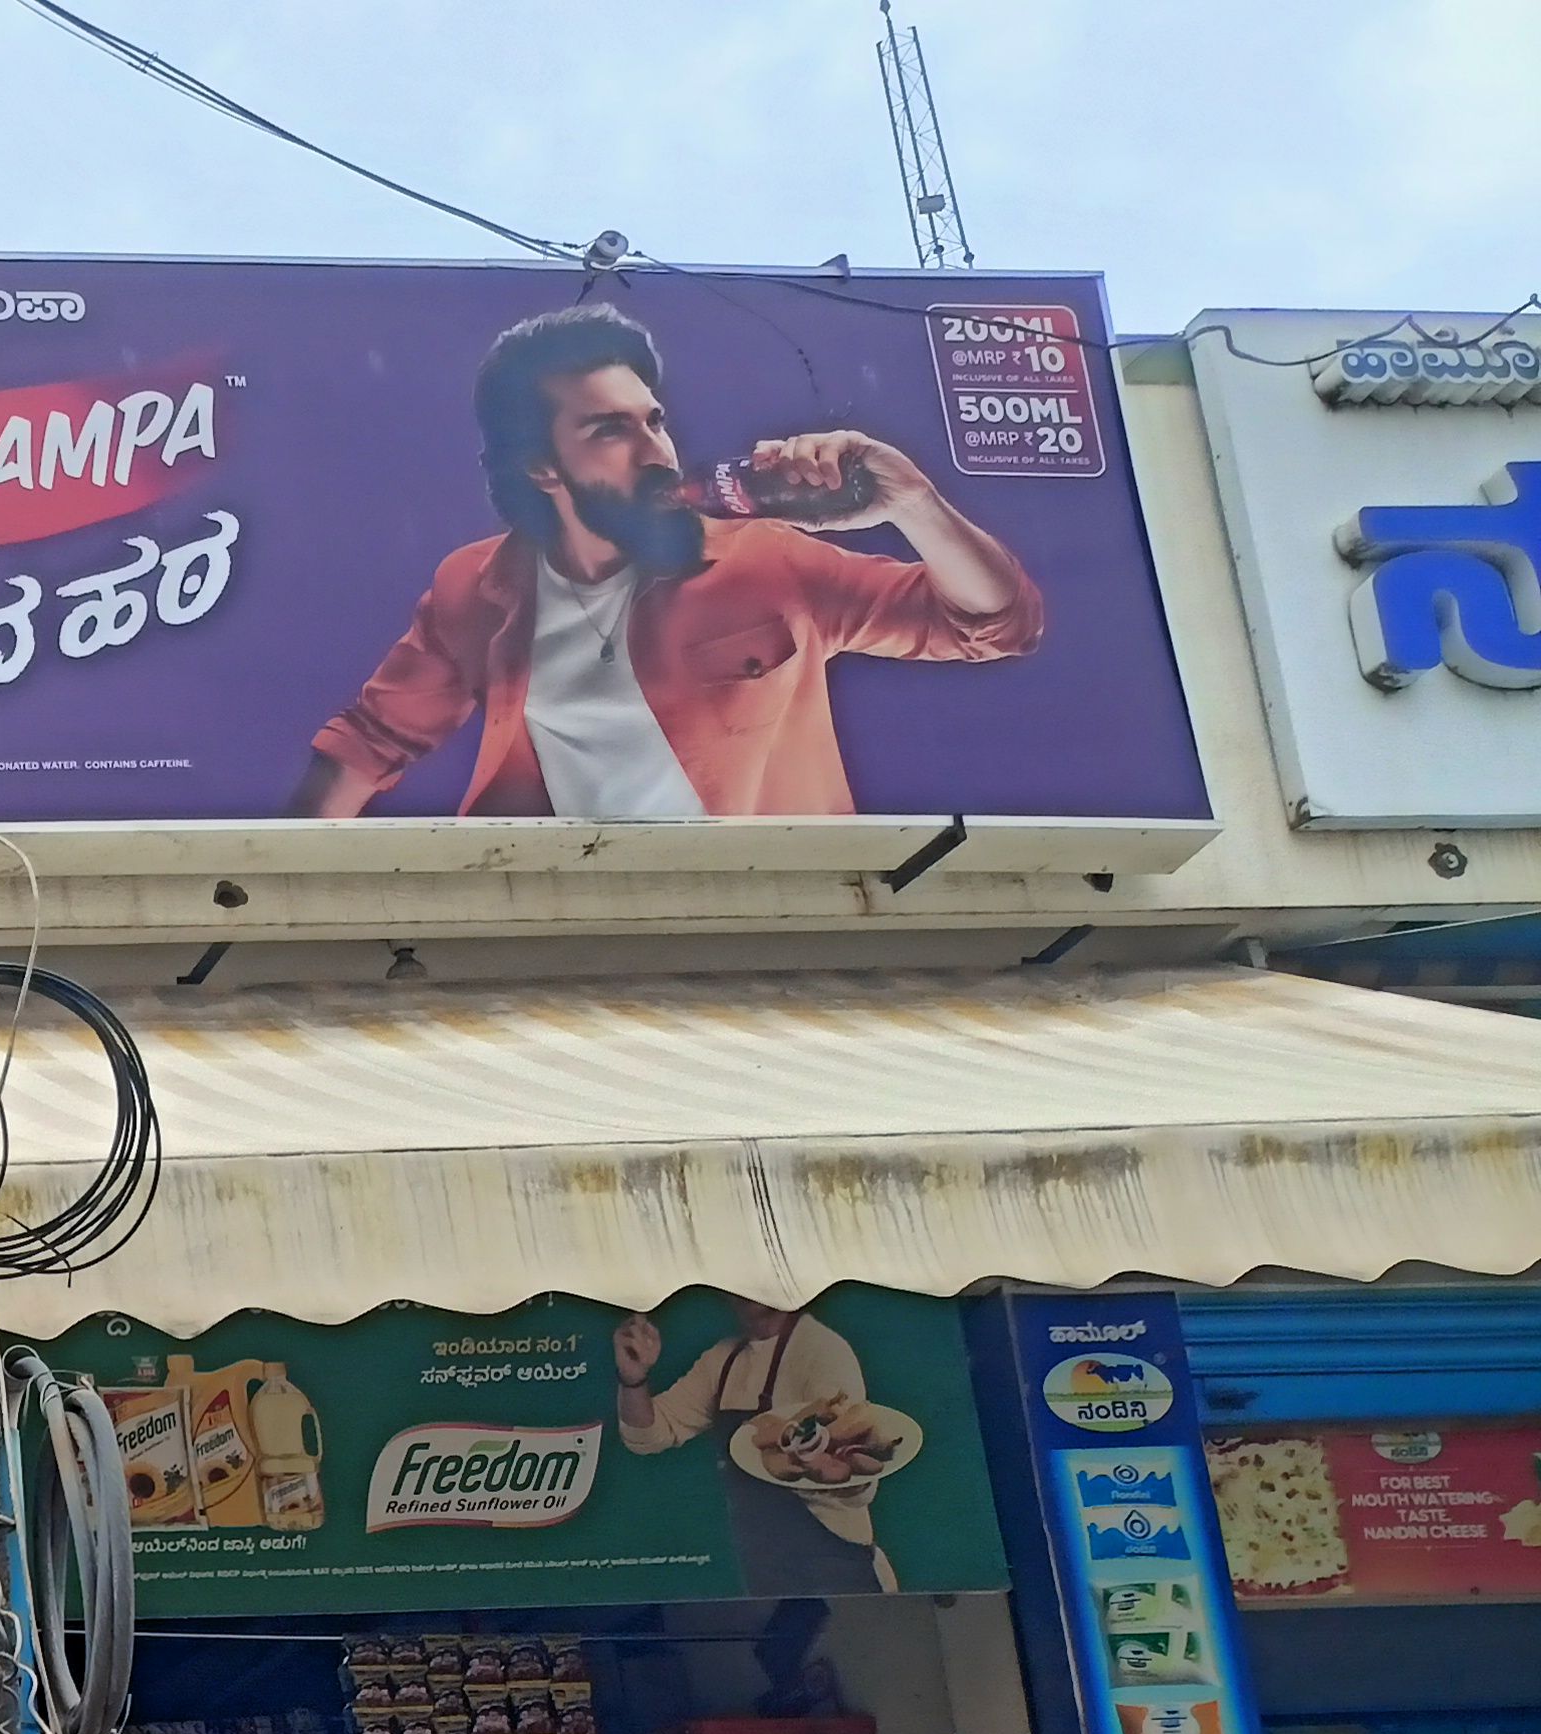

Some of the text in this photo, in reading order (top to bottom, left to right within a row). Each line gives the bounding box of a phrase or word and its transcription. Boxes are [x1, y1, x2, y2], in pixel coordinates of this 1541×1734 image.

[952, 350, 1006, 366] @MRP
[958, 396, 1083, 424] 500ML
[964, 431, 1019, 447] @MRP
[84, 760, 137, 770] CONTAINS
[391, 1440, 579, 1496] Freedom
[1380, 1475, 1451, 1490] FOR BEST
[385, 1495, 567, 1514] Refined Sunflower Oil
[1351, 1491, 1493, 1507] MOUTH WATERING
[1363, 1524, 1488, 1540] NANDINI CHEESE
